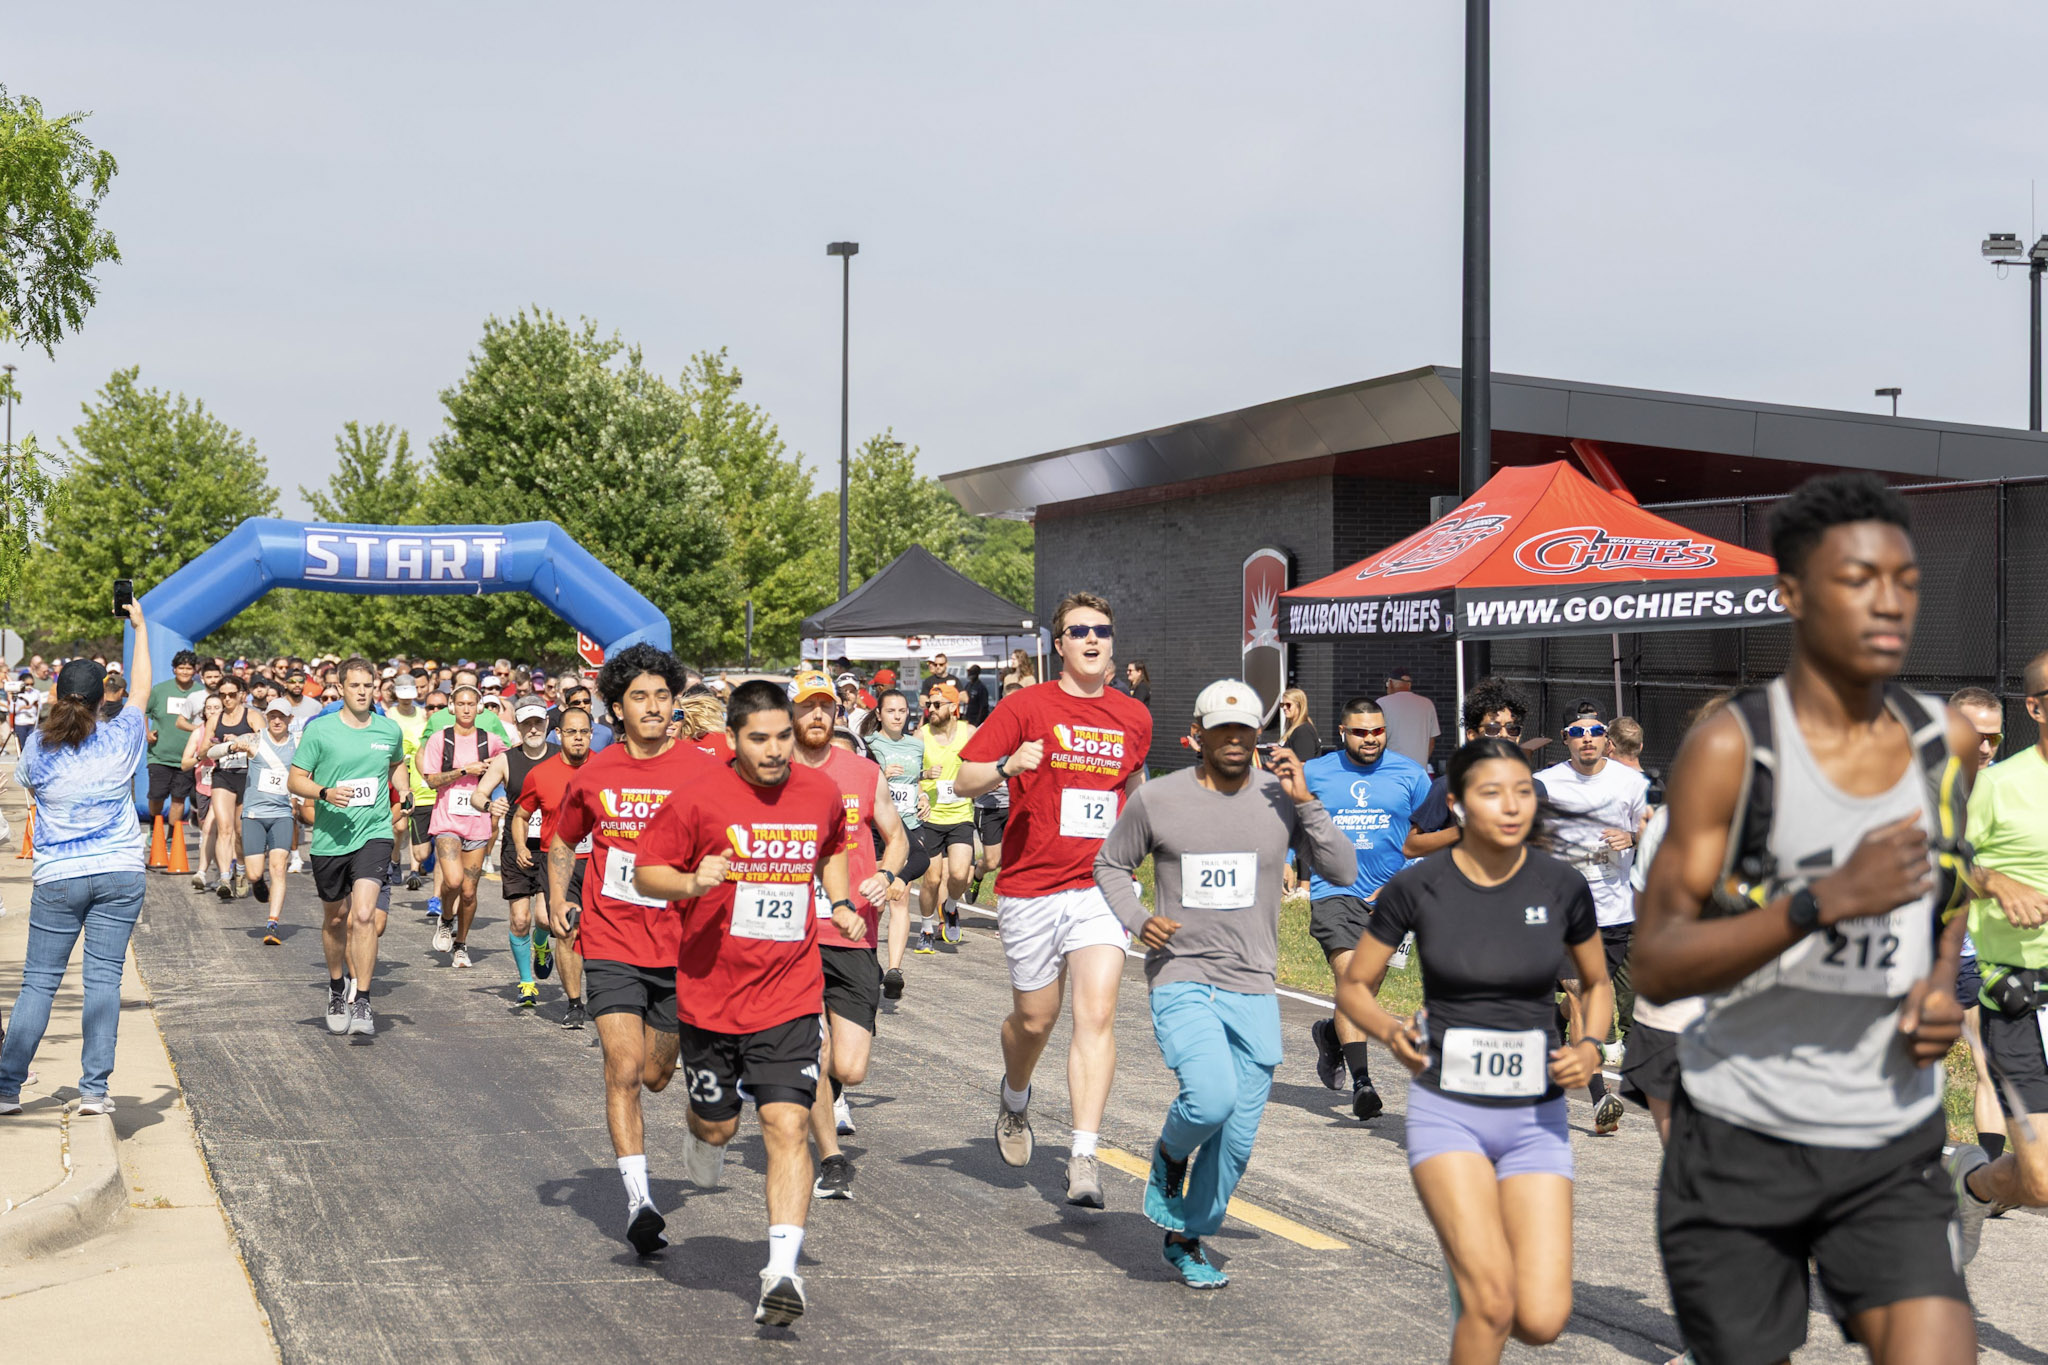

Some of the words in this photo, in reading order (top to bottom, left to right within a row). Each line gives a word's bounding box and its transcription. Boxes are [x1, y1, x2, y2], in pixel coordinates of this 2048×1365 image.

[1608, 538, 1680, 546] WAUBONSEE
[305, 534, 506, 579] START
[1514, 526, 1718, 575] CHIEFS
[1290, 602, 1379, 634] WAUBONSEE
[1381, 599, 1440, 633] CHIEFS
[1073, 730, 1101, 742] TRAIL
[1103, 733, 1124, 744] RUN
[1073, 738, 1124, 758] 2026
[1050, 761, 1068, 769] ONE
[1068, 763, 1086, 771] STEP
[1086, 765, 1096, 773] AT
[1103, 768, 1119, 776] TIME
[1052, 753, 1085, 764] FUELING
[1086, 756, 1122, 769] FUTURES
[270, 776, 281, 785] 32
[622, 793, 653, 803] TRAIL
[890, 790, 908, 801] 202
[1084, 803, 1104, 820] 12
[601, 821, 636, 830] FUELING
[620, 830, 640, 838] STEP
[752, 830, 788, 841] TRAIL
[790, 830, 817, 840] RUN
[752, 840, 816, 859] 2026
[769, 862, 812, 873] FUTURES
[746, 872, 769, 881] STEP
[770, 872, 782, 881] AT
[782, 873, 791, 882] A
[792, 873, 812, 882] TIME
[1200, 868, 1236, 888] 201
[756, 898, 792, 918] 123
[1823, 934, 1900, 968] 212
[1472, 1039, 1500, 1048] TRAIL
[1502, 1040, 1524, 1048] RUN
[1471, 1052, 1523, 1077] 108
[686, 1066, 722, 1103] 23
